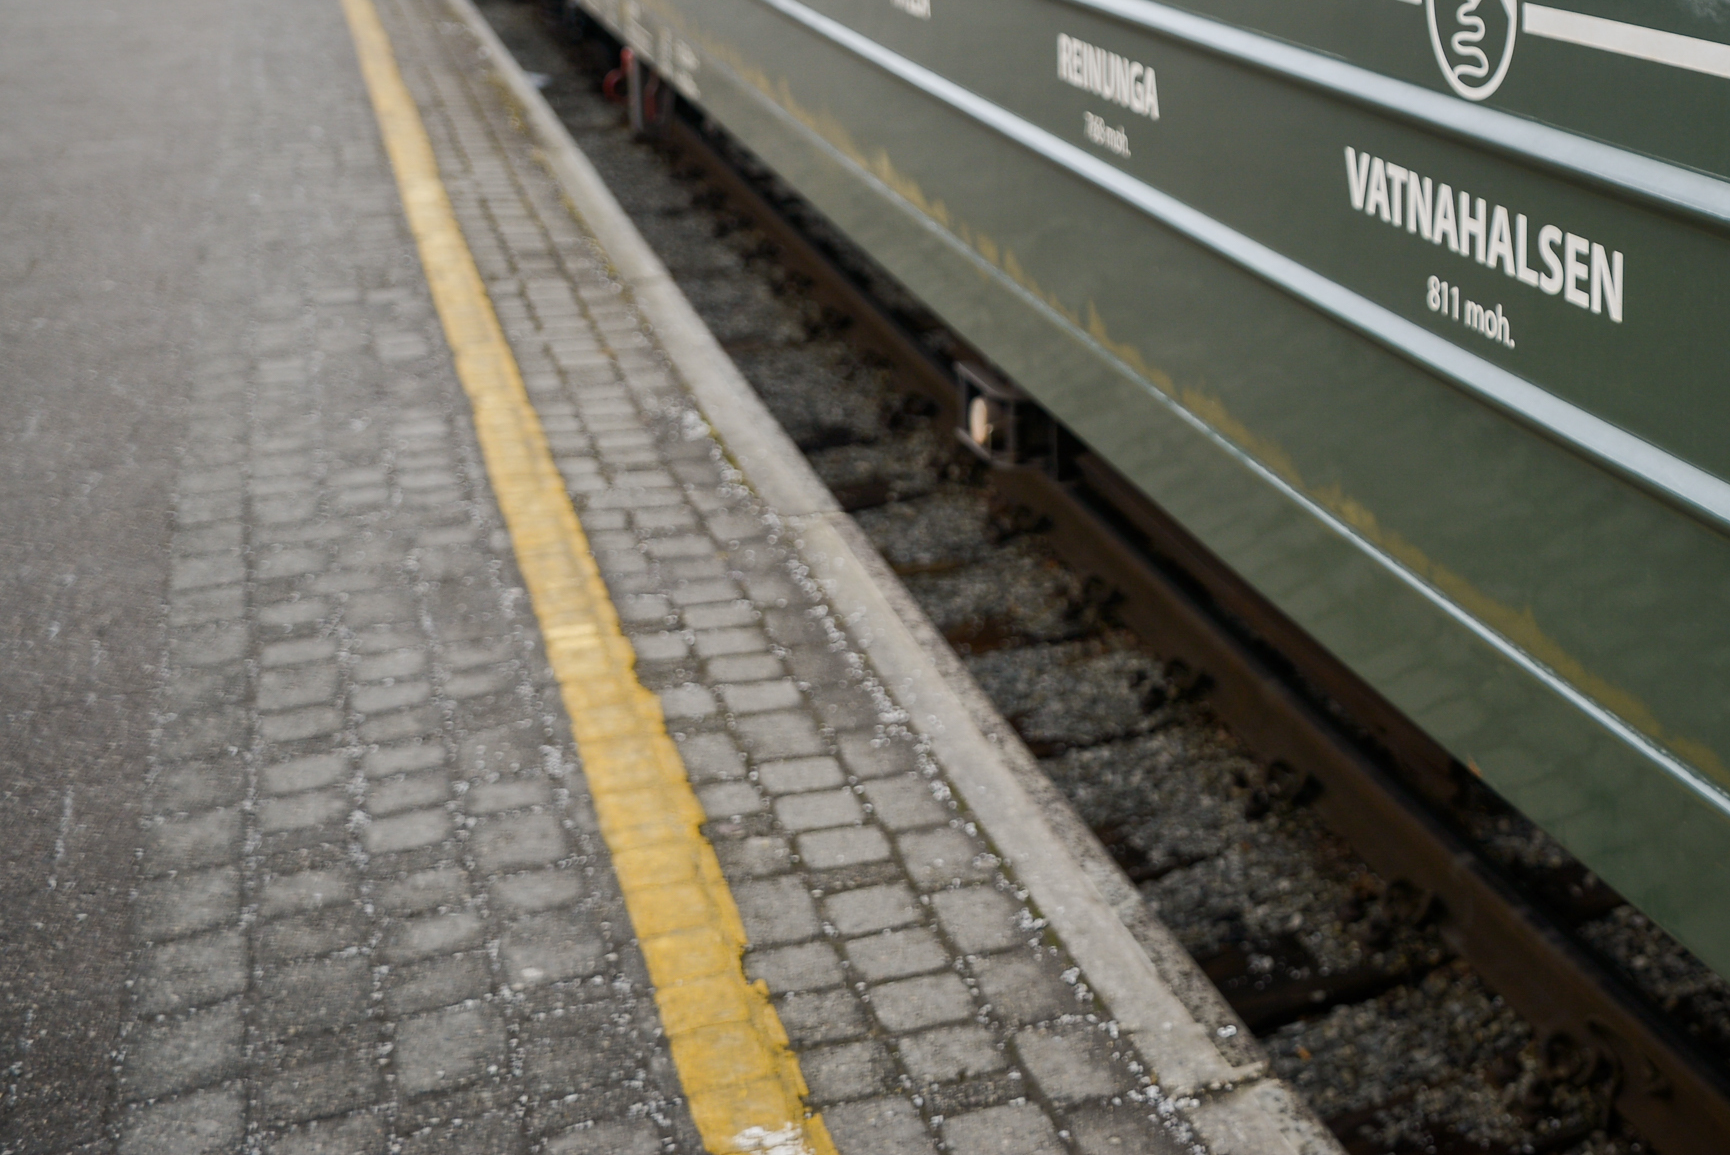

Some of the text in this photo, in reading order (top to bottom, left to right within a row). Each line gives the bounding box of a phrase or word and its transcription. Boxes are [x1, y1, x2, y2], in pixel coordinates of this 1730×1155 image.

[1057, 32, 1160, 121] REINUNGA
[1344, 146, 1624, 323] VATNAHALSEN
[1426, 276, 1516, 348] 811 moh.
